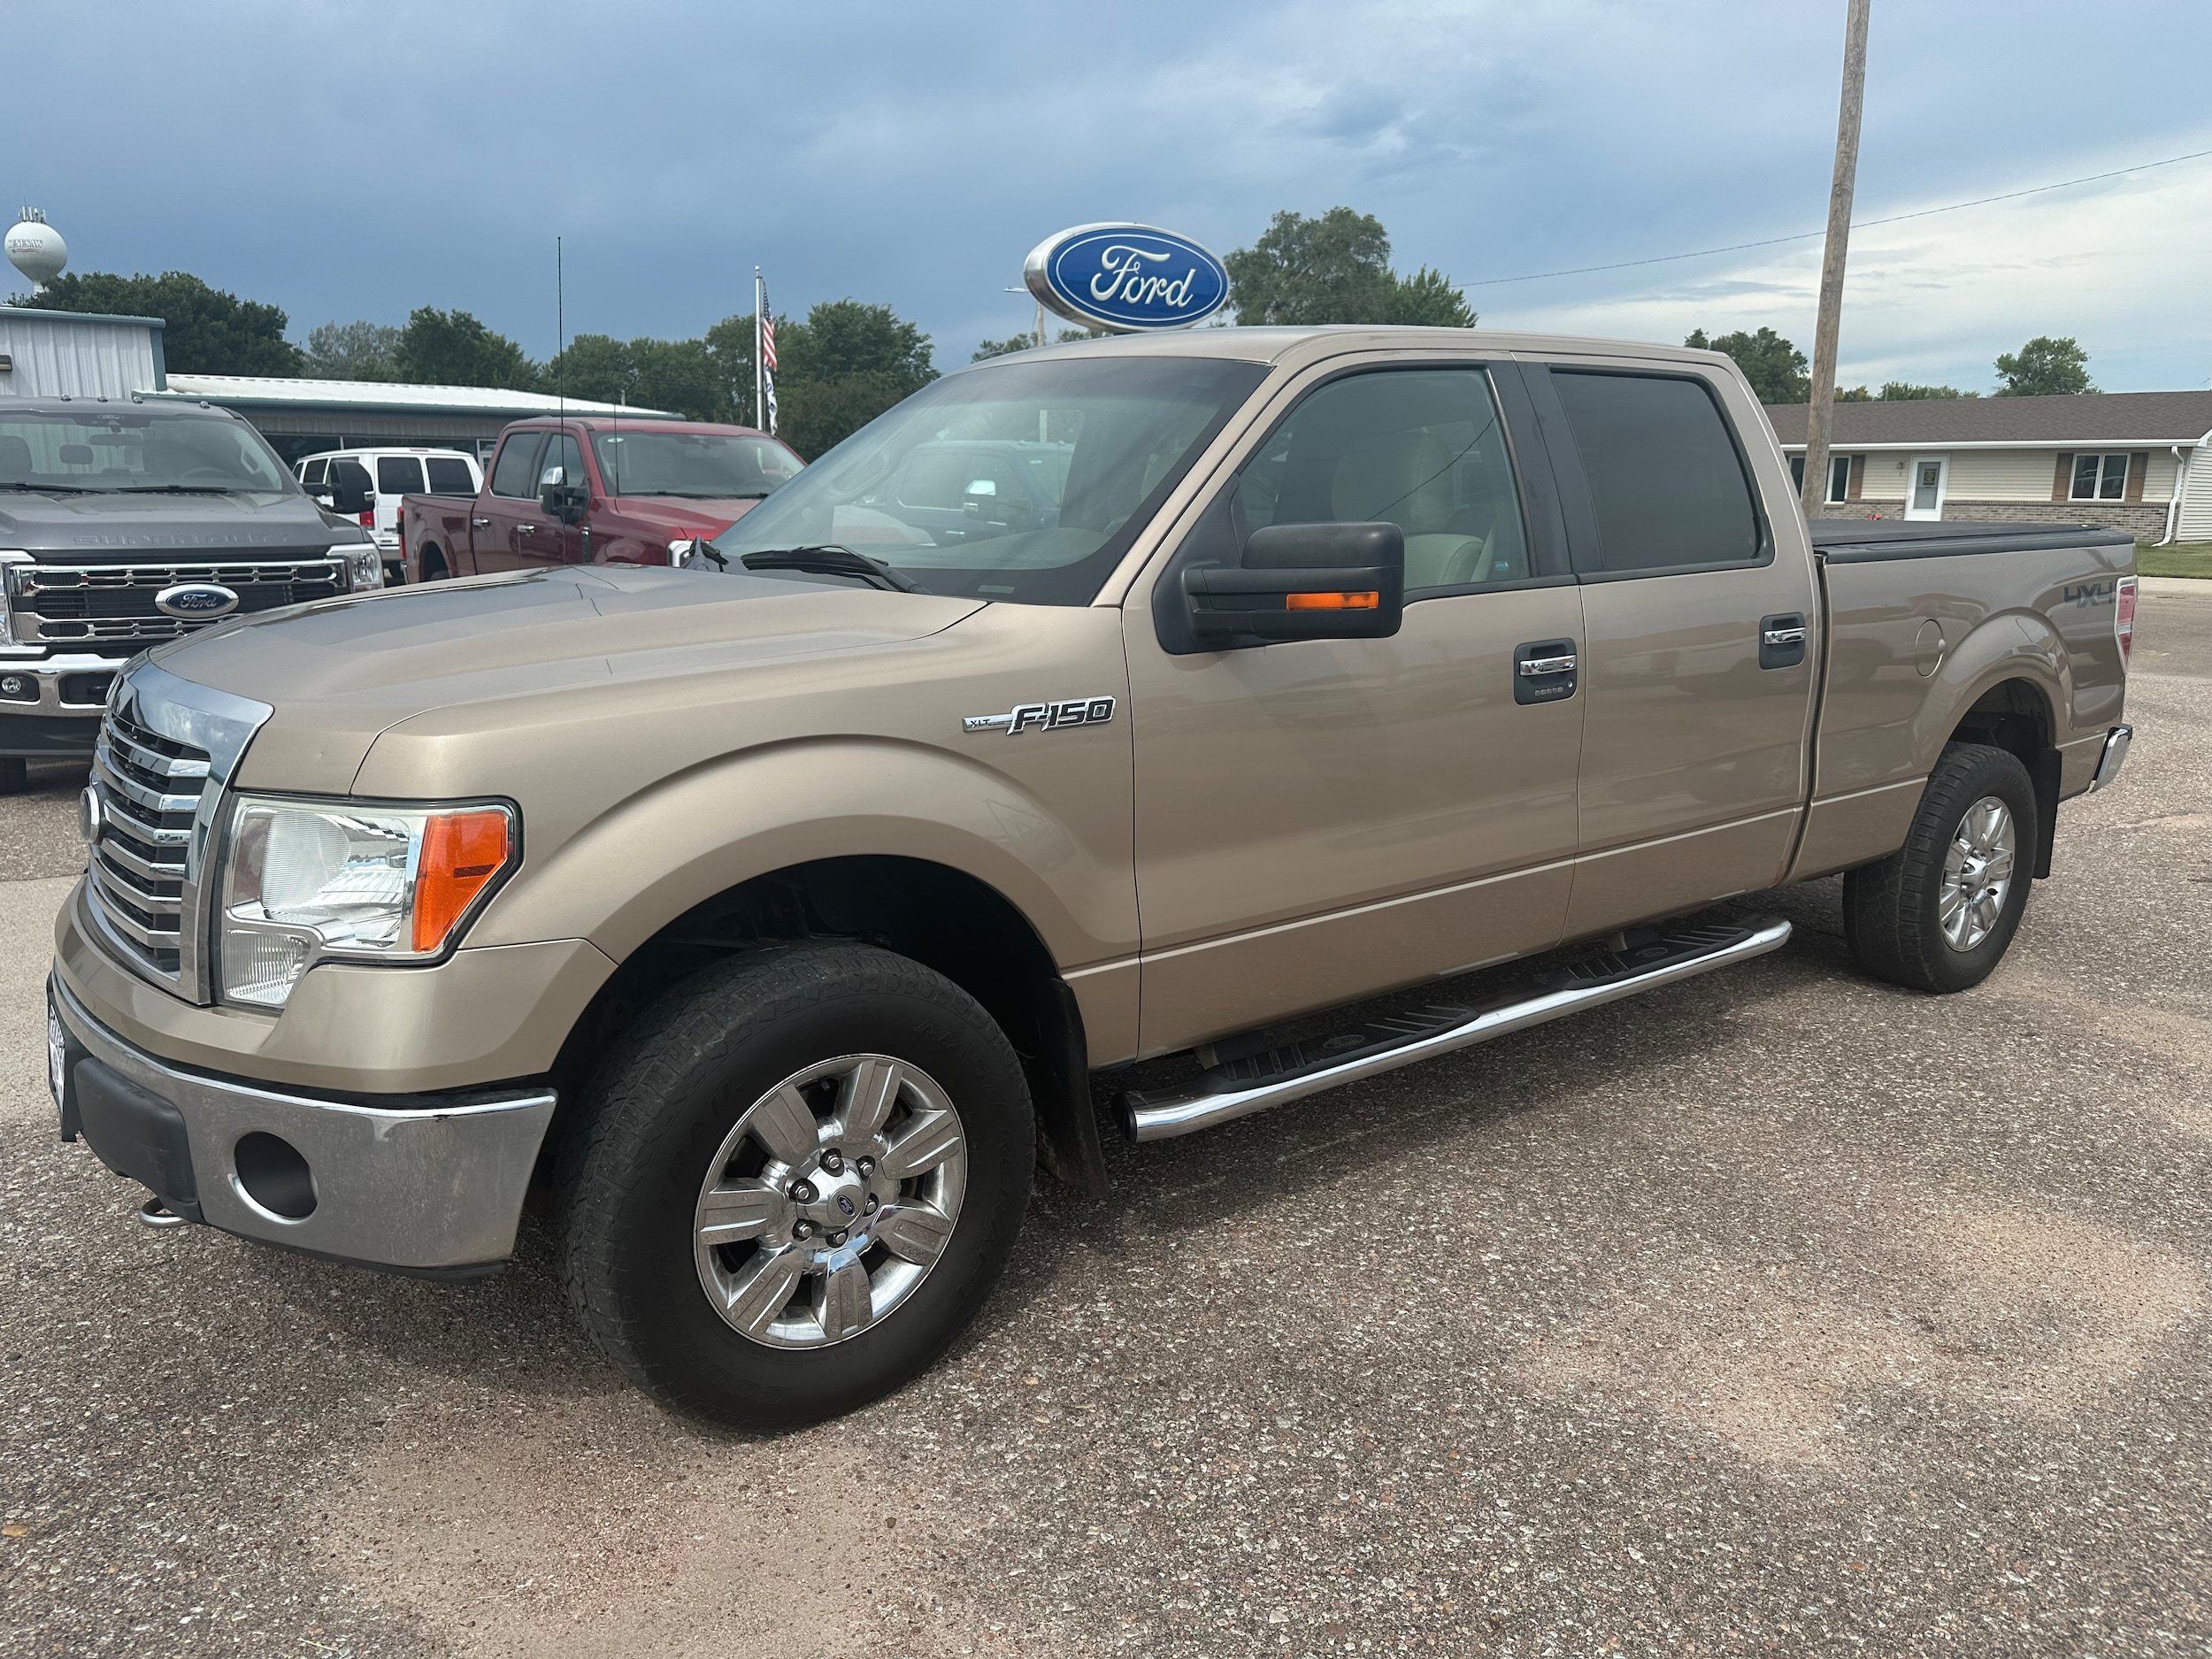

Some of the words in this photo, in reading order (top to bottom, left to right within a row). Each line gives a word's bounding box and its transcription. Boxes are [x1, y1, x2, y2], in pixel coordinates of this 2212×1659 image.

[1090, 245, 1196, 308] Ford
[180, 593, 218, 609] Ford
[2063, 582, 2116, 608] 4X4
[970, 718, 990, 727] XLT
